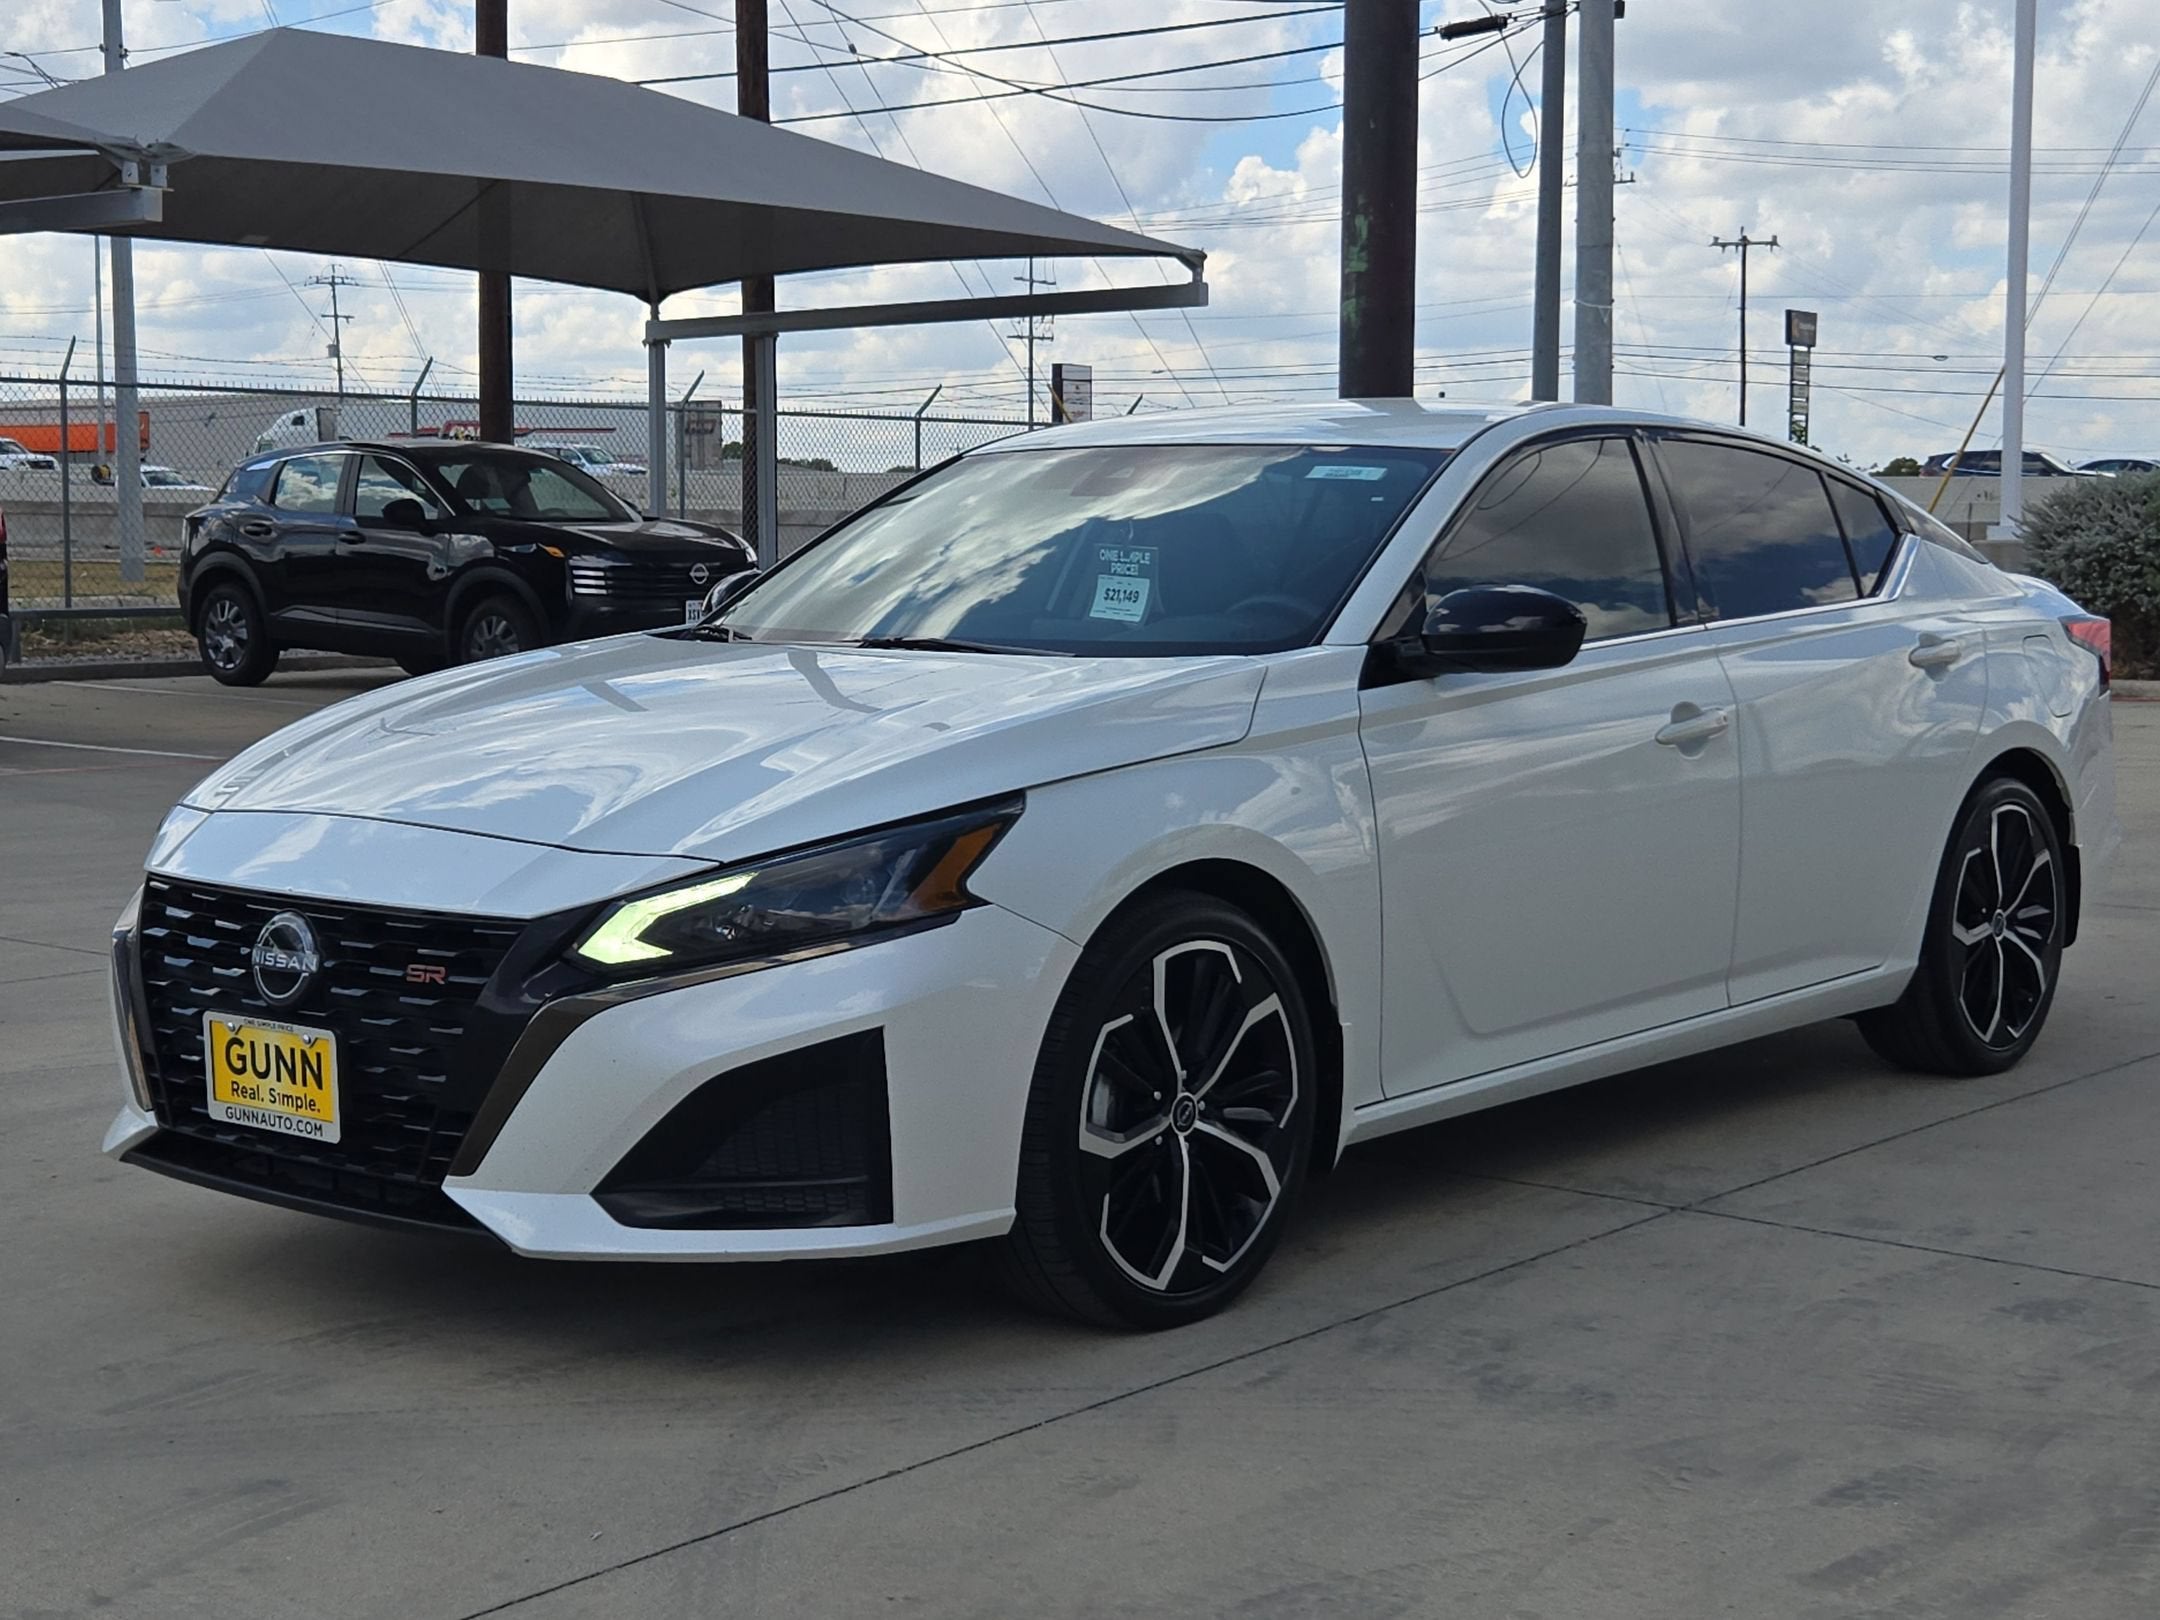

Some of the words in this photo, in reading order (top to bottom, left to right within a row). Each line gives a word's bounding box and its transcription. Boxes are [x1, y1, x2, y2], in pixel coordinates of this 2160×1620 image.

[1100, 549, 1118, 562] ONE
[1103, 588, 1140, 604] $21,149
[252, 951, 318, 972] NISSAN
[406, 964, 446, 985] SR
[225, 1037, 323, 1091] GUNN
[231, 1080, 264, 1102] Real.
[268, 1088, 321, 1113] Simple.
[225, 1106, 324, 1137] GUNNAUTO.COM
